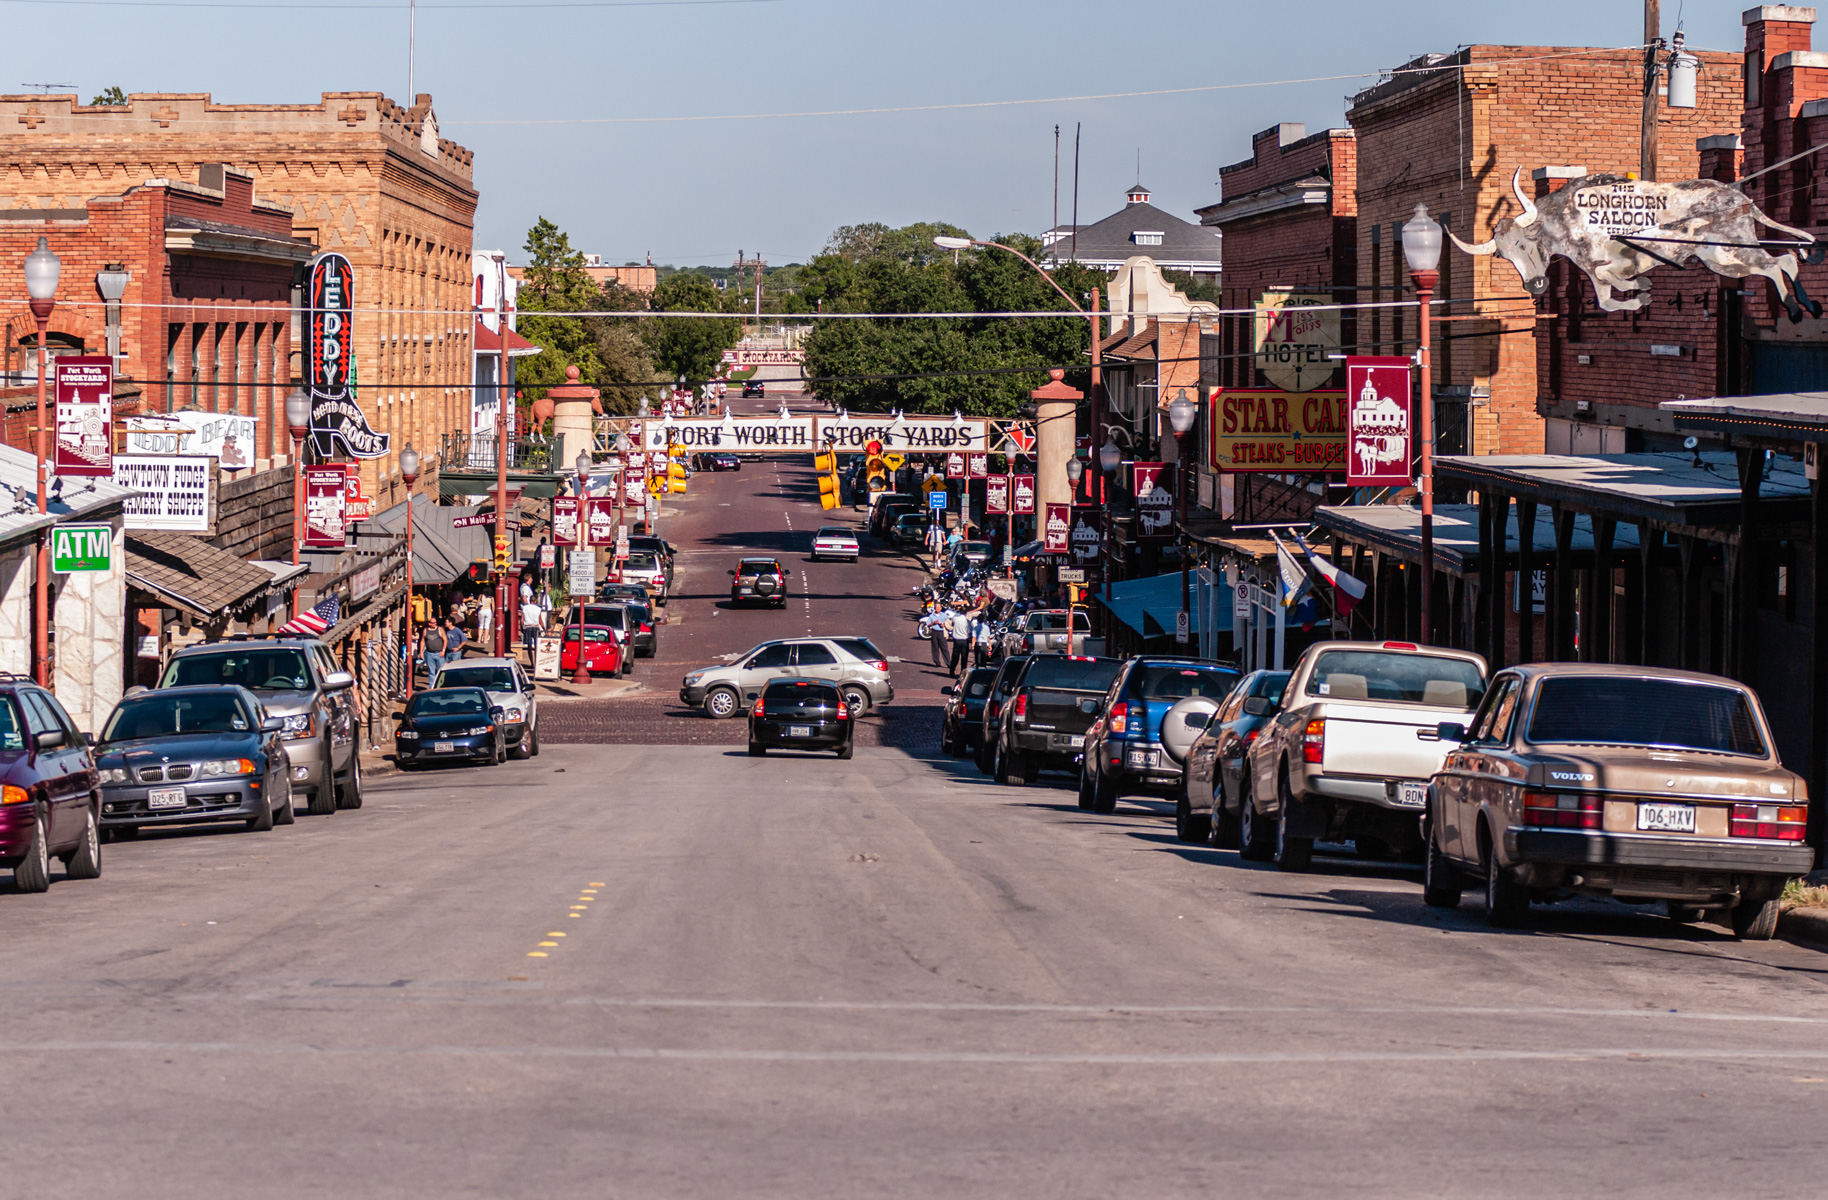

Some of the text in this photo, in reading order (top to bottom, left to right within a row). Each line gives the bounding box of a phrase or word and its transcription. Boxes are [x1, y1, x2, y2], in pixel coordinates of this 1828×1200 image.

[1611, 184, 1635, 193] THE
[1577, 193, 1668, 210] LONGHORN
[1588, 210, 1656, 226] SALOON
[322, 261, 342, 386] LEDDY
[741, 352, 796, 363] STOCKYARDS
[1264, 343, 1333, 363] HOTEL
[60, 374, 108, 382] STOCKYARDS
[1222, 396, 1347, 433] STAR CAF
[129, 418, 254, 453] TEDDY BEAR
[732, 425, 807, 446] WORTH
[822, 425, 972, 447] STOCK YARDS
[118, 464, 205, 488] COWTOWN FUDGE
[167, 492, 205, 516] SHOPPE
[469, 514, 486, 525] Main
[55, 531, 109, 559] ATM
[1551, 771, 1594, 782] VOLVO
